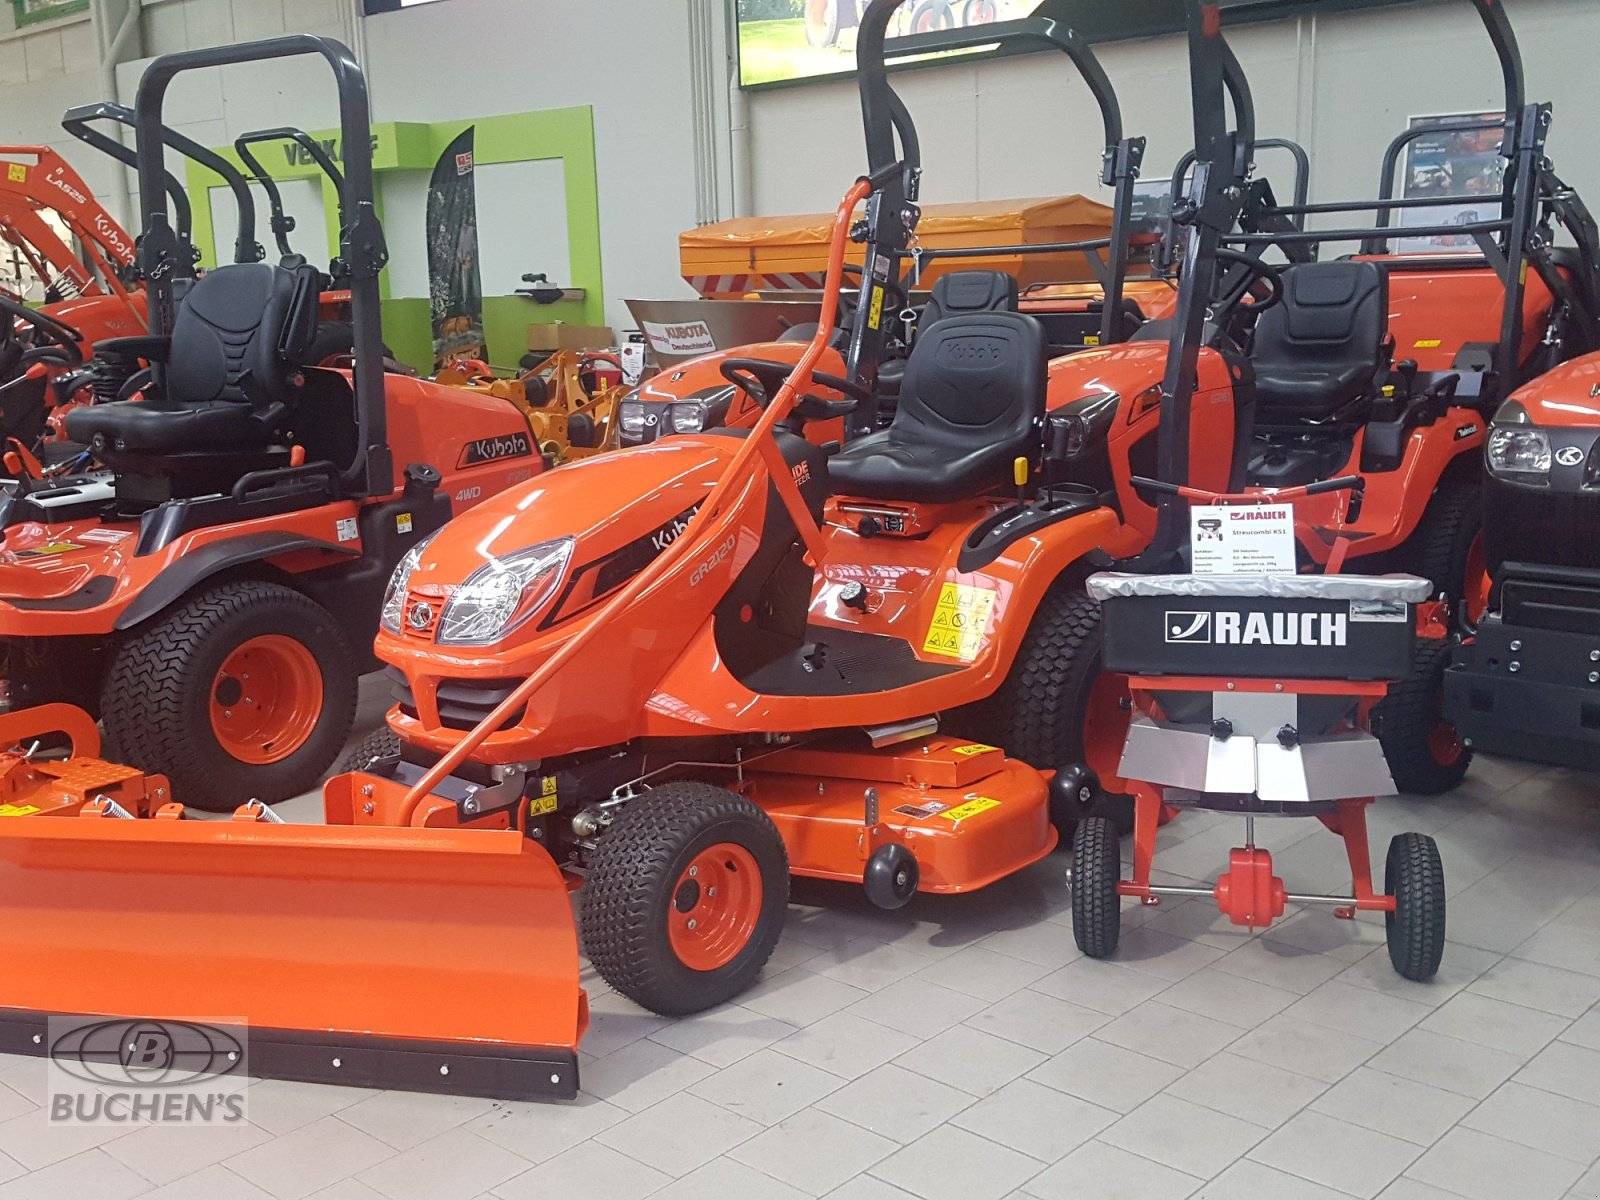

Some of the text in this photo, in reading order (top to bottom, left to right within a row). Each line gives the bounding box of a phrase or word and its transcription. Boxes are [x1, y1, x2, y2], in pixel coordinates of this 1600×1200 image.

[46, 173, 87, 204] LA525
[95, 213, 136, 266] Kubota
[664, 324, 709, 340] KUBOTA
[671, 340, 713, 351] Deutschland
[475, 434, 527, 459] Kubota
[455, 485, 481, 501] 4WD
[1246, 510, 1287, 520] RAUCH
[688, 533, 736, 587] GR2120
[1215, 611, 1347, 646] RAUCH
